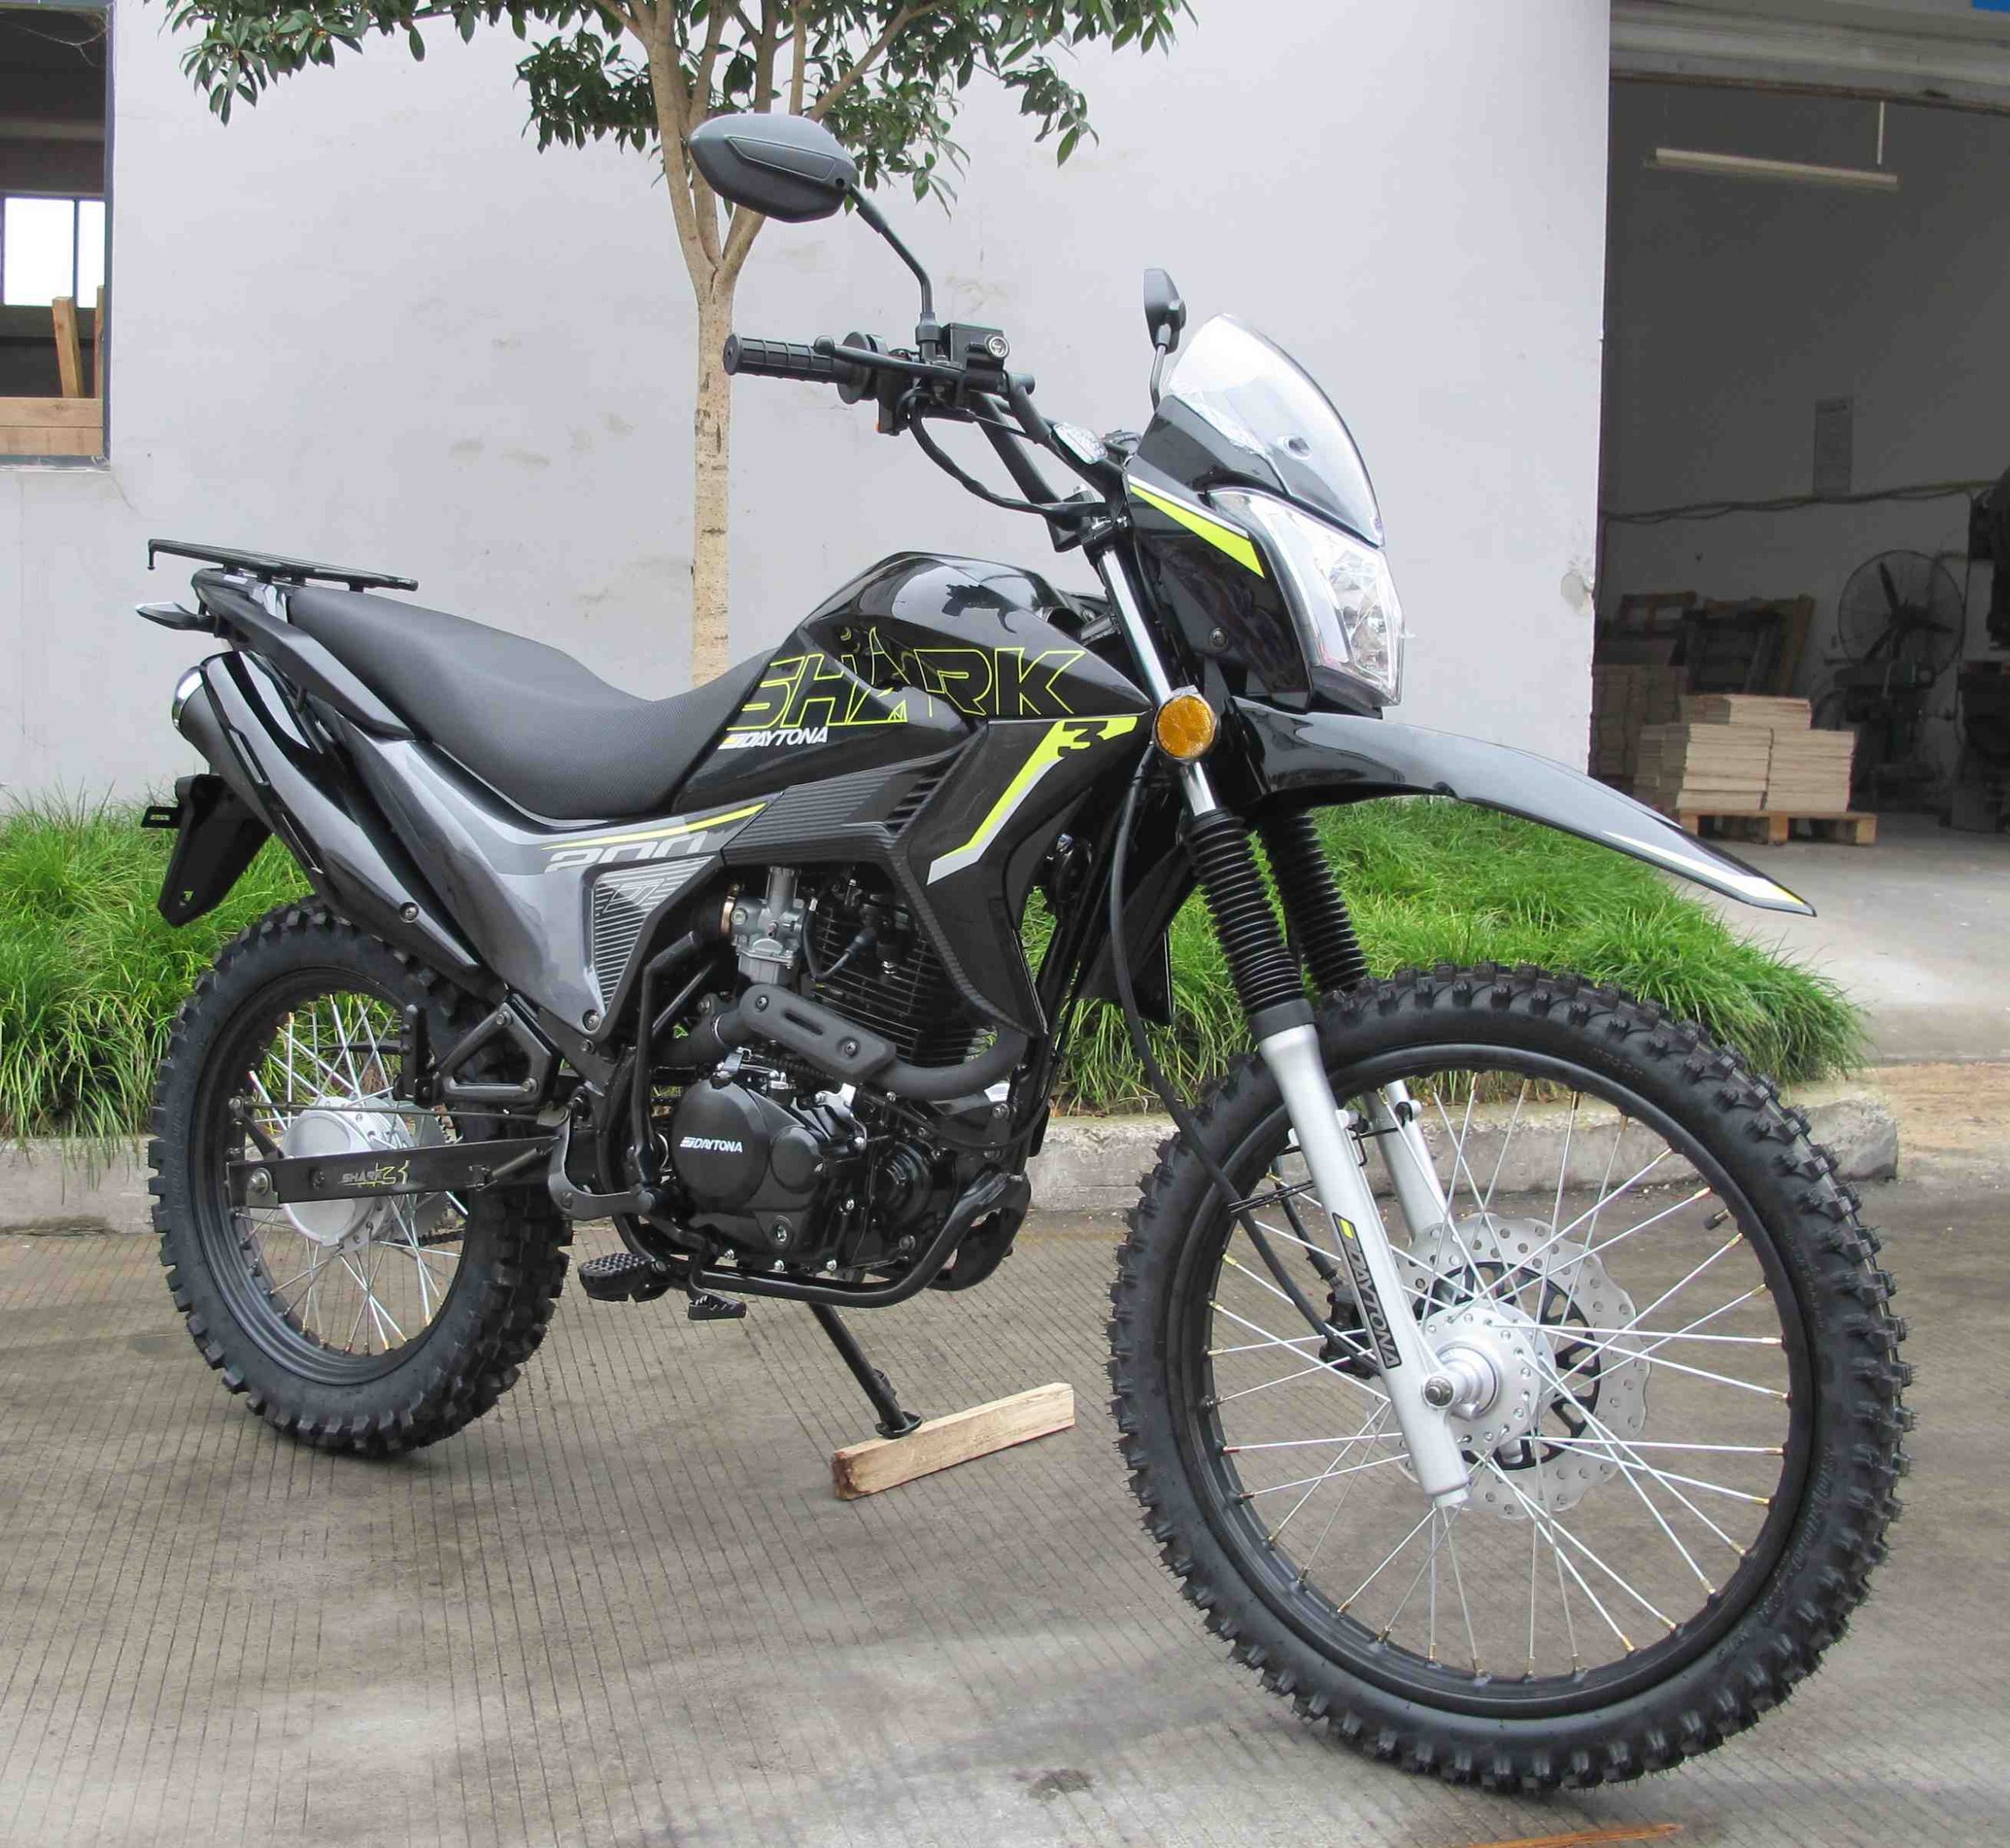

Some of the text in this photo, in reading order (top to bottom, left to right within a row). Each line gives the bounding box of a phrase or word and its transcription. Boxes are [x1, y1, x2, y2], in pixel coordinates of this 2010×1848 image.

[725, 626, 1087, 731] SHARK
[735, 725, 829, 748] DAYTONA
[689, 1137, 743, 1153] DAYTONA
[1348, 1248, 1401, 1364] DAYTONA
